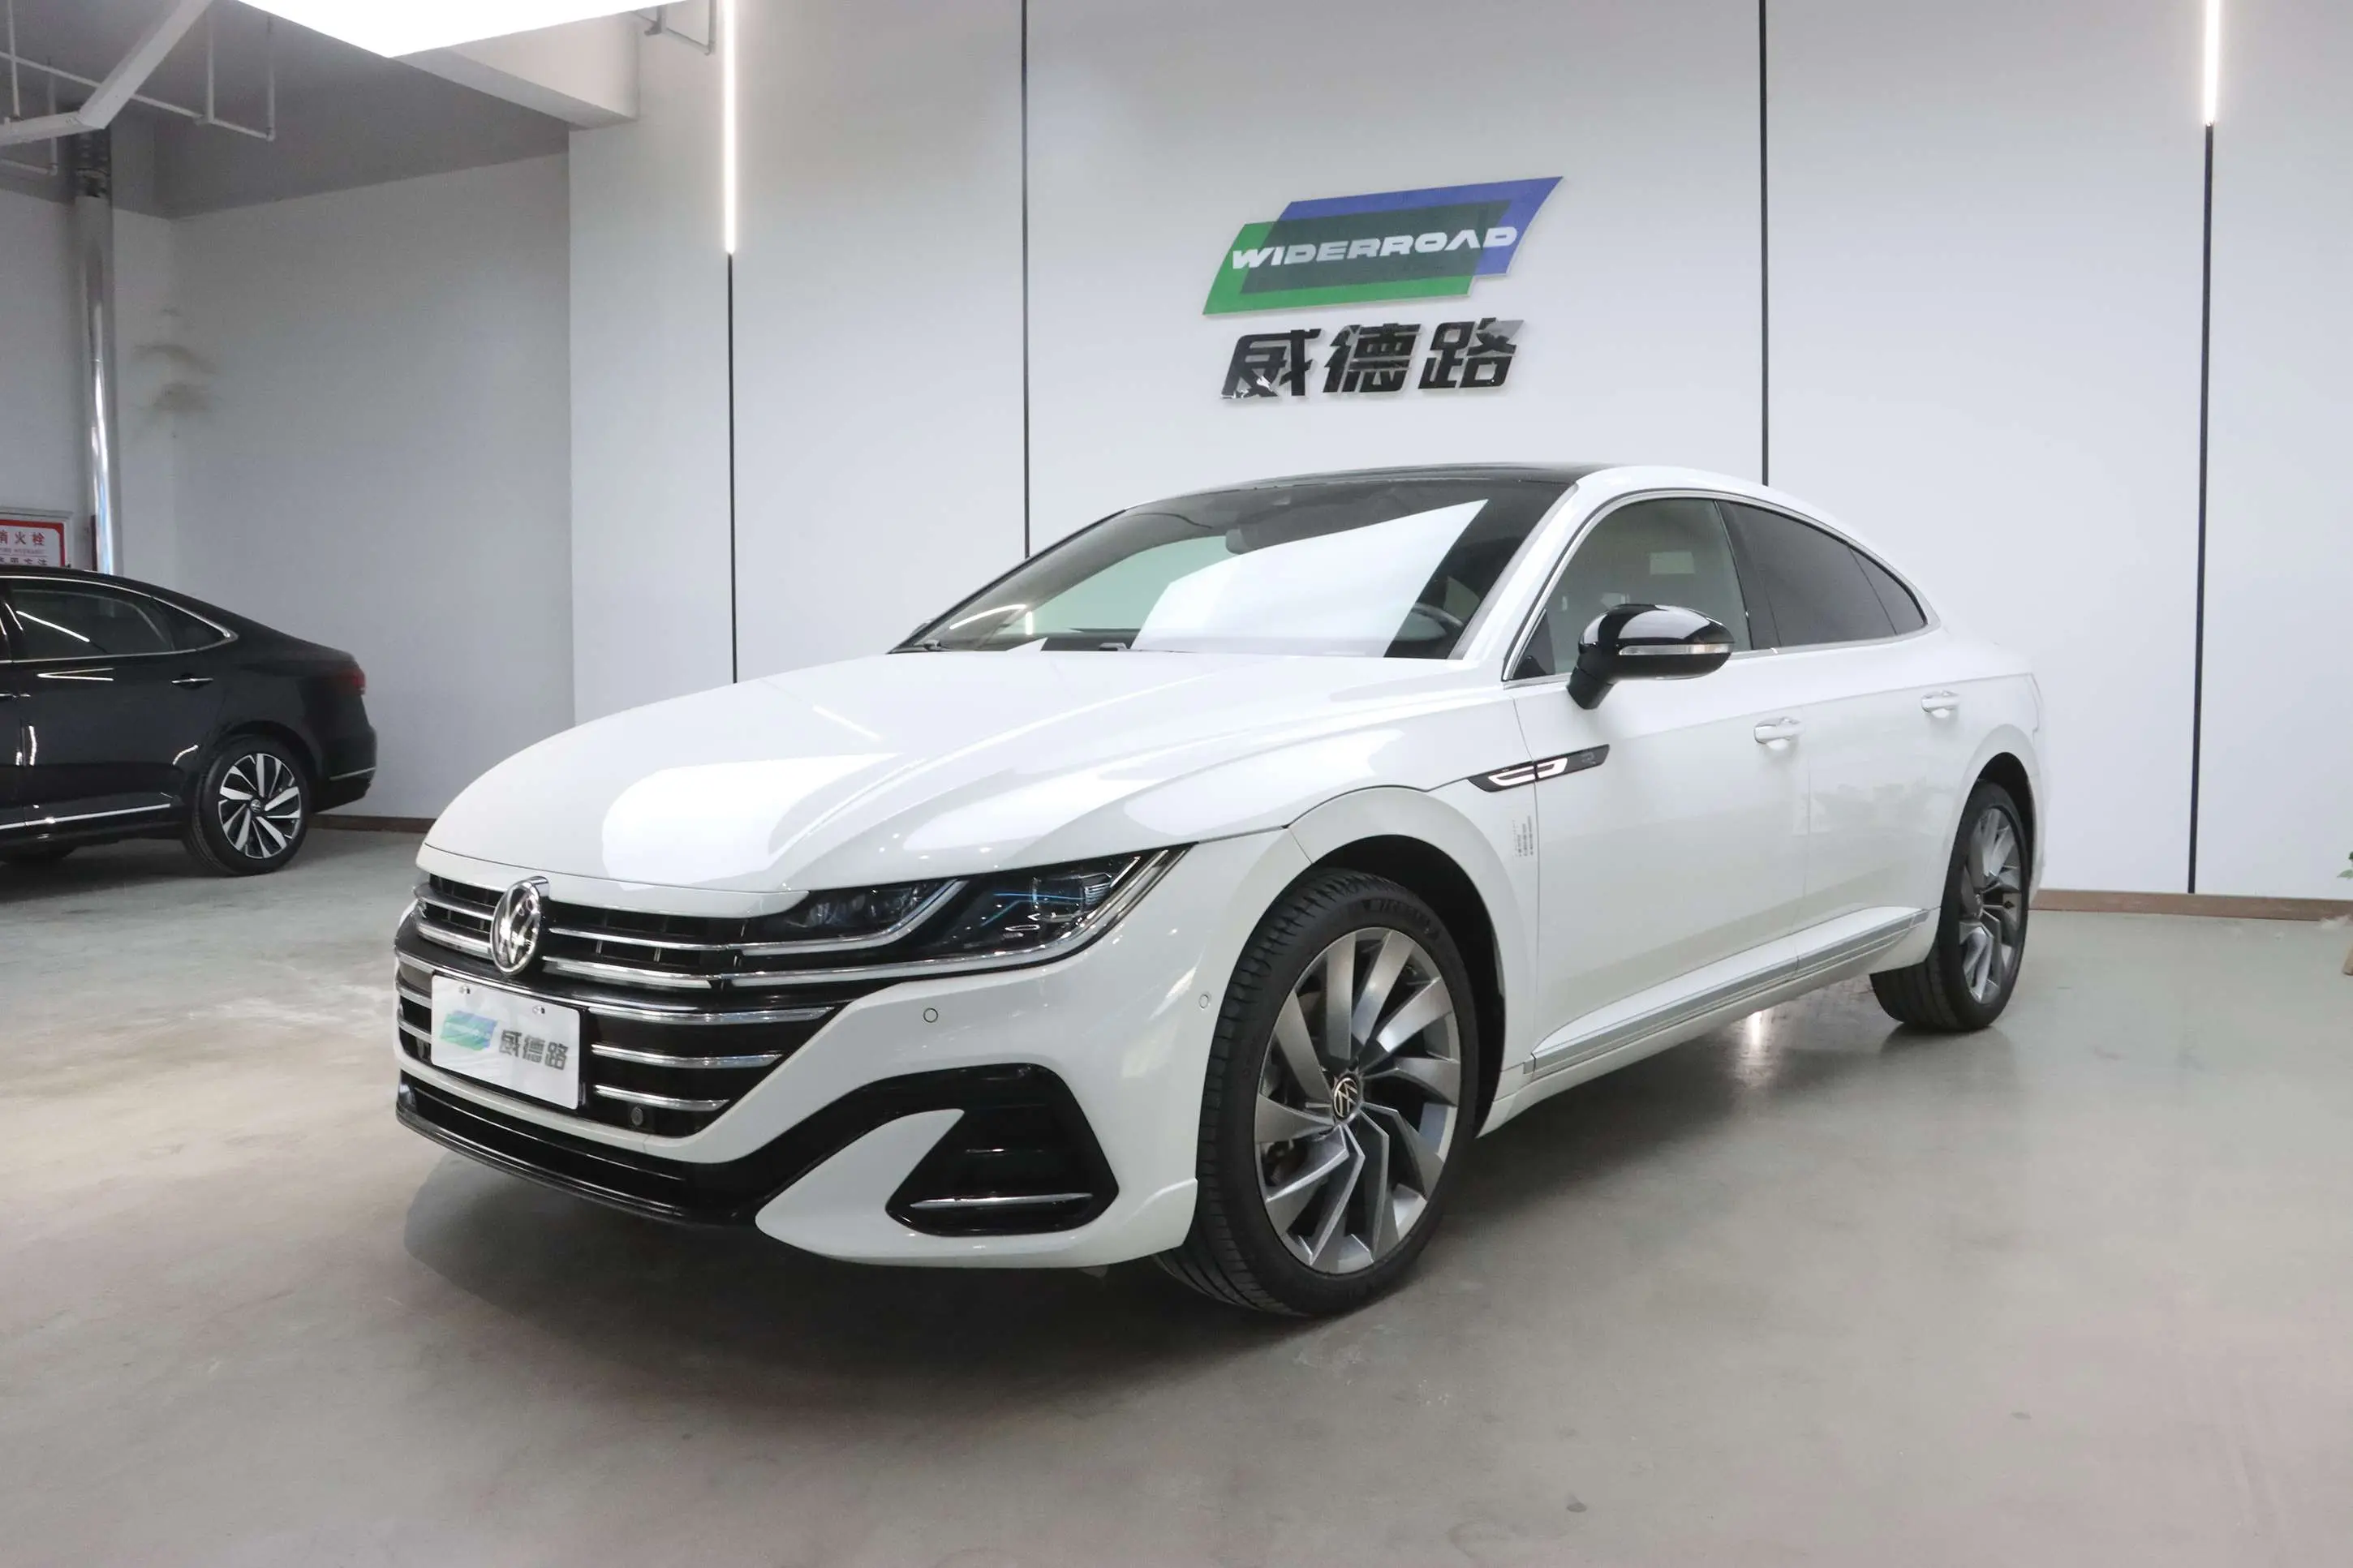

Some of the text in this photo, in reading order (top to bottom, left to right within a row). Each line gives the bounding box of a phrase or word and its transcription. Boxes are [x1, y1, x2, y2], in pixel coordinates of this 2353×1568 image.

[1232, 226, 1517, 269] WIDERROAD
[1220, 317, 1525, 399] 威德路
[498, 1028, 569, 1071] 威德路
